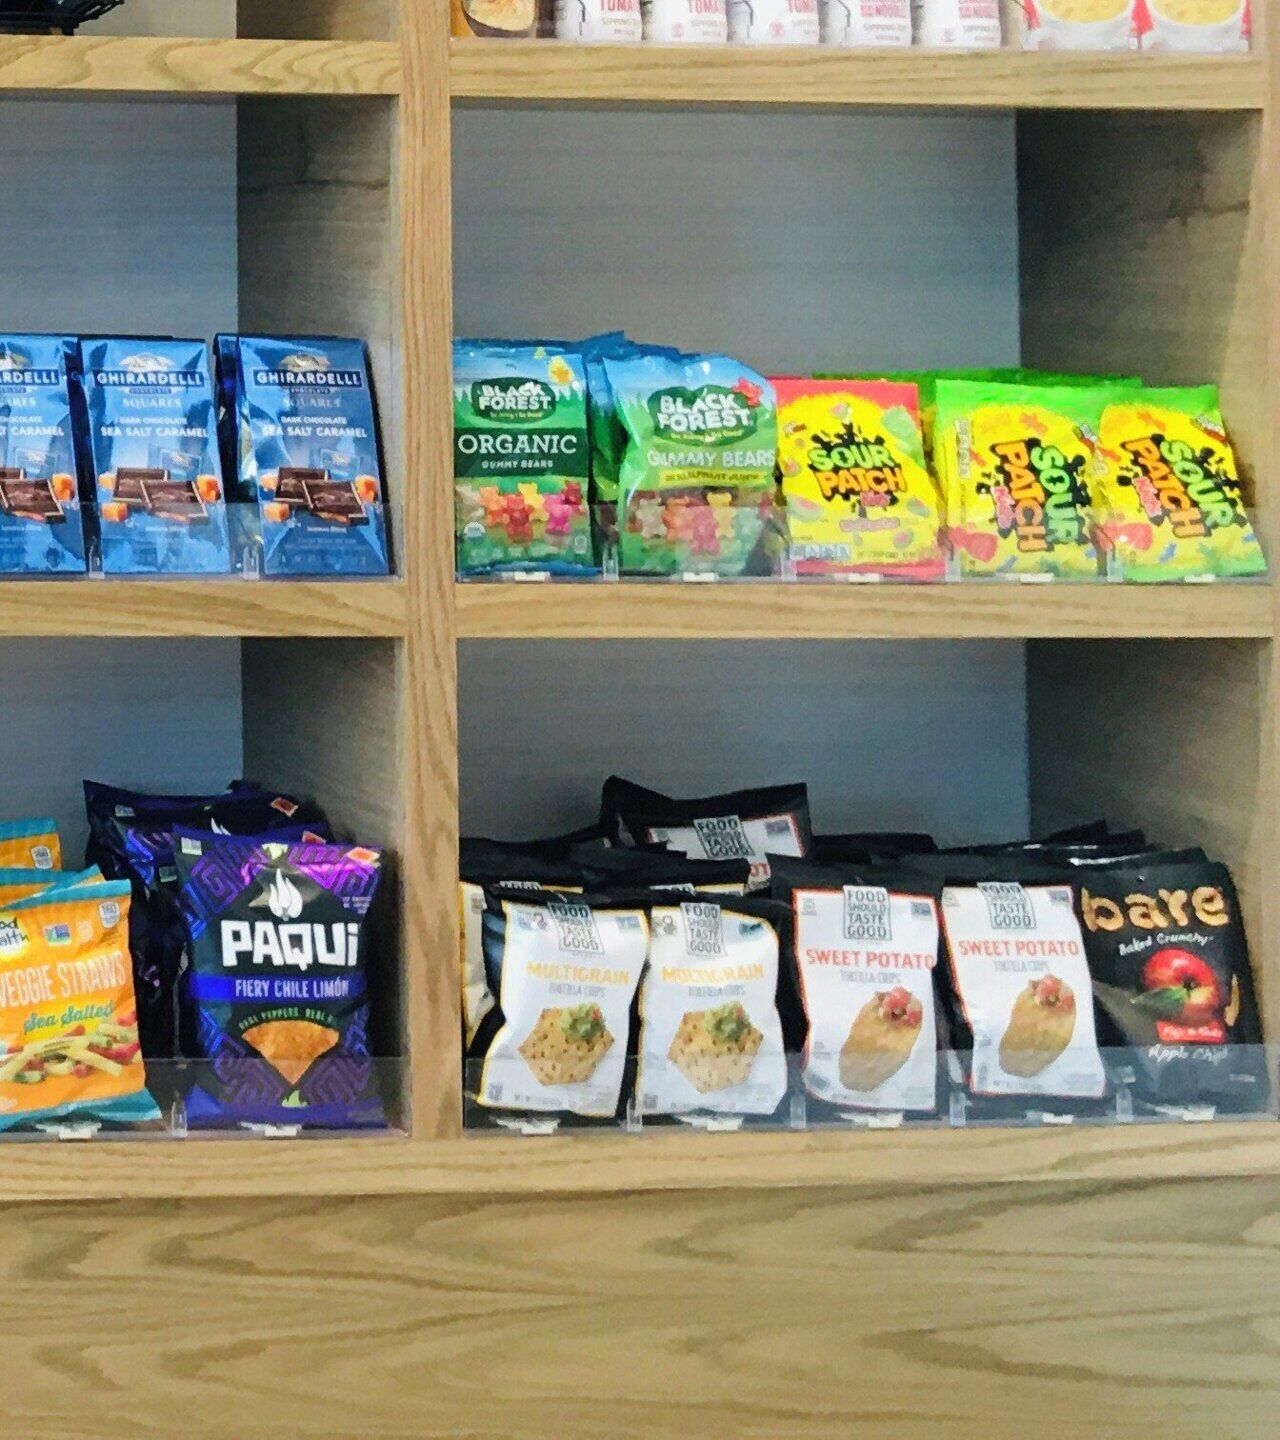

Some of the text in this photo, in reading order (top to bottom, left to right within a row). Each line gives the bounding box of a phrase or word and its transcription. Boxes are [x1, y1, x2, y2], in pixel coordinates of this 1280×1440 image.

[96, 371, 204, 387] GHIRARDELLI
[256, 371, 361, 387] GHIRARDELLI
[479, 396, 551, 411] FOREST
[659, 394, 737, 414] BLACK
[656, 409, 752, 431] FOREST
[9, 426, 65, 437] CARAMEL
[100, 427, 209, 439] SEA SALT CARAMEL
[286, 426, 312, 437] SALT
[314, 426, 368, 439] CARAMEL
[458, 434, 577, 455] ORGANIC
[647, 448, 776, 468] GUMMY BEARS
[807, 442, 893, 470] SOUR
[481, 460, 554, 469] GUMMY BEARS
[816, 468, 906, 498] PATCH
[1121, 437, 1207, 539] PATCH
[1159, 440, 1235, 527] SOUR
[995, 440, 1048, 552] PATCH
[1030, 443, 1080, 545] SOUR
[696, 819, 739, 833] FOOD
[847, 889, 886, 904] FOOD
[551, 905, 590, 918] FOOD
[684, 905, 718, 918] FOOD
[848, 903, 886, 913] SHOULD
[992, 902, 1028, 915] TASTE
[1080, 885, 1231, 932] bare
[848, 913, 886, 925] TASTE
[993, 914, 1032, 927] GOOD
[690, 927, 721, 940] TASTE
[848, 925, 887, 939] GOOD
[562, 937, 599, 951] GOOD
[690, 939, 722, 954] GOOD
[957, 939, 1080, 957] SWEET POTATO
[1118, 933, 1210, 956] Baked Crunchy
[805, 949, 935, 971] SWEET POTATO
[59, 953, 126, 999] STRAWS
[525, 962, 630, 985] MULTIGRAIN
[662, 963, 766, 983] MULTIGRAIN
[235, 979, 270, 999] FIERY
[274, 979, 311, 998] CHILE
